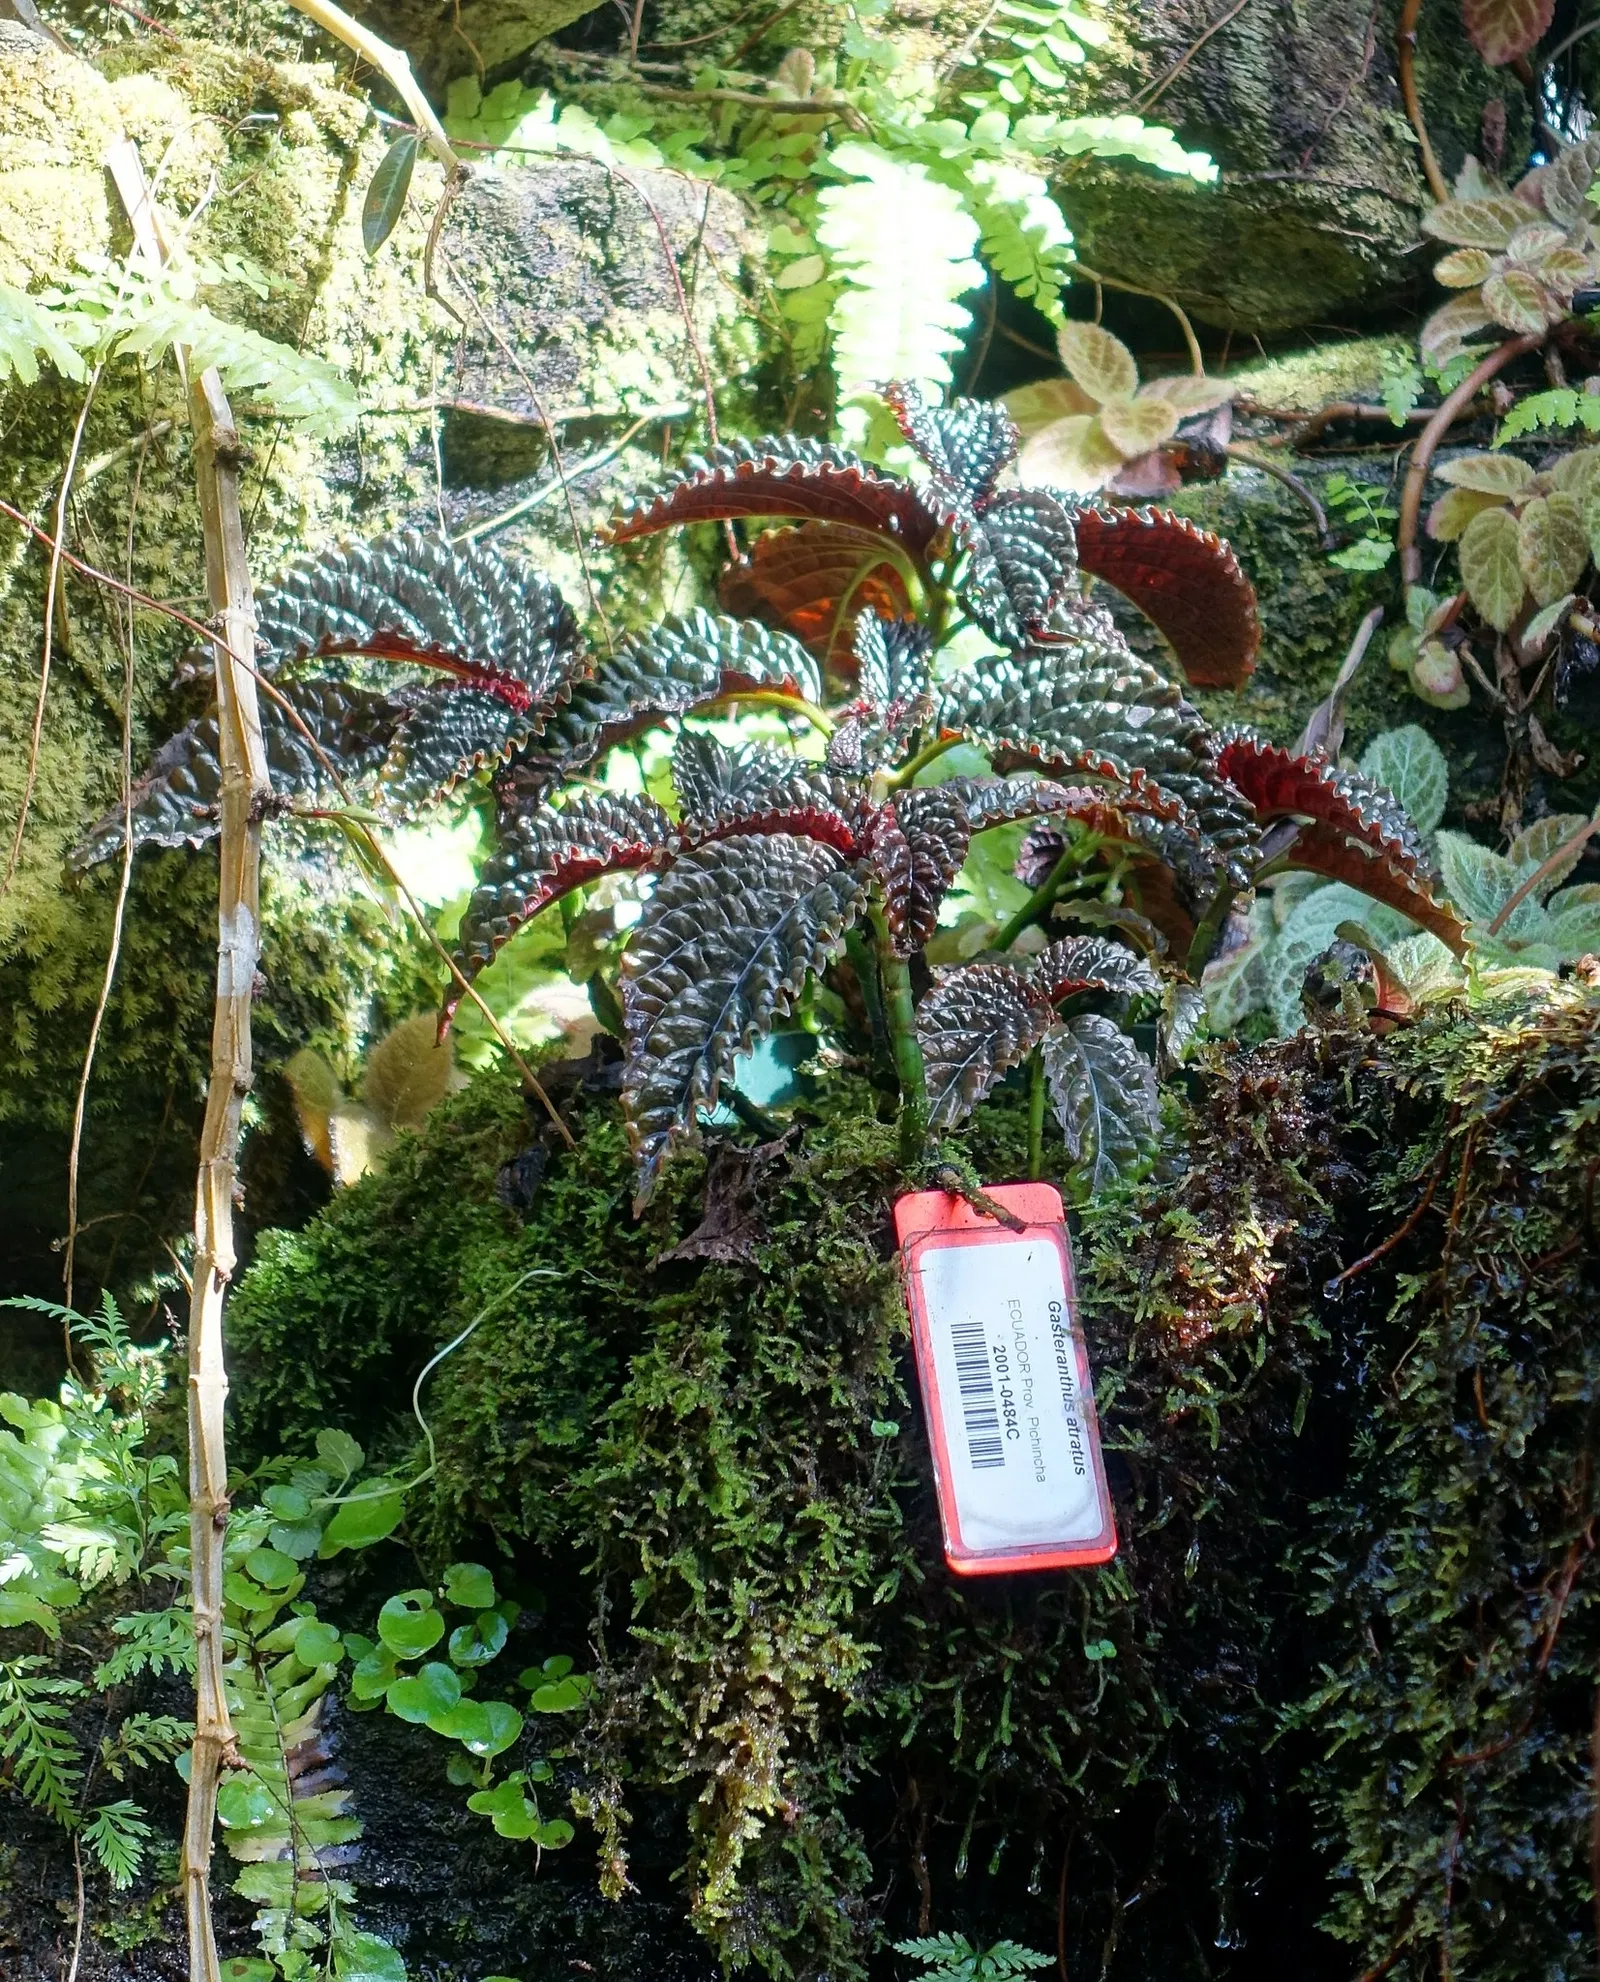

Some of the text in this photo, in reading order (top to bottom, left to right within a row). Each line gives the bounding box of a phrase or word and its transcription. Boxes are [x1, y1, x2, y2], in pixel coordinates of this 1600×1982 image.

[992, 1344, 1020, 1441] 2001-0484C
[1007, 1299, 1031, 1374] ECUADOR
[1027, 1416, 1046, 1483] Pichincha
[1047, 1300, 1086, 1476] Gasteranthus atratus
